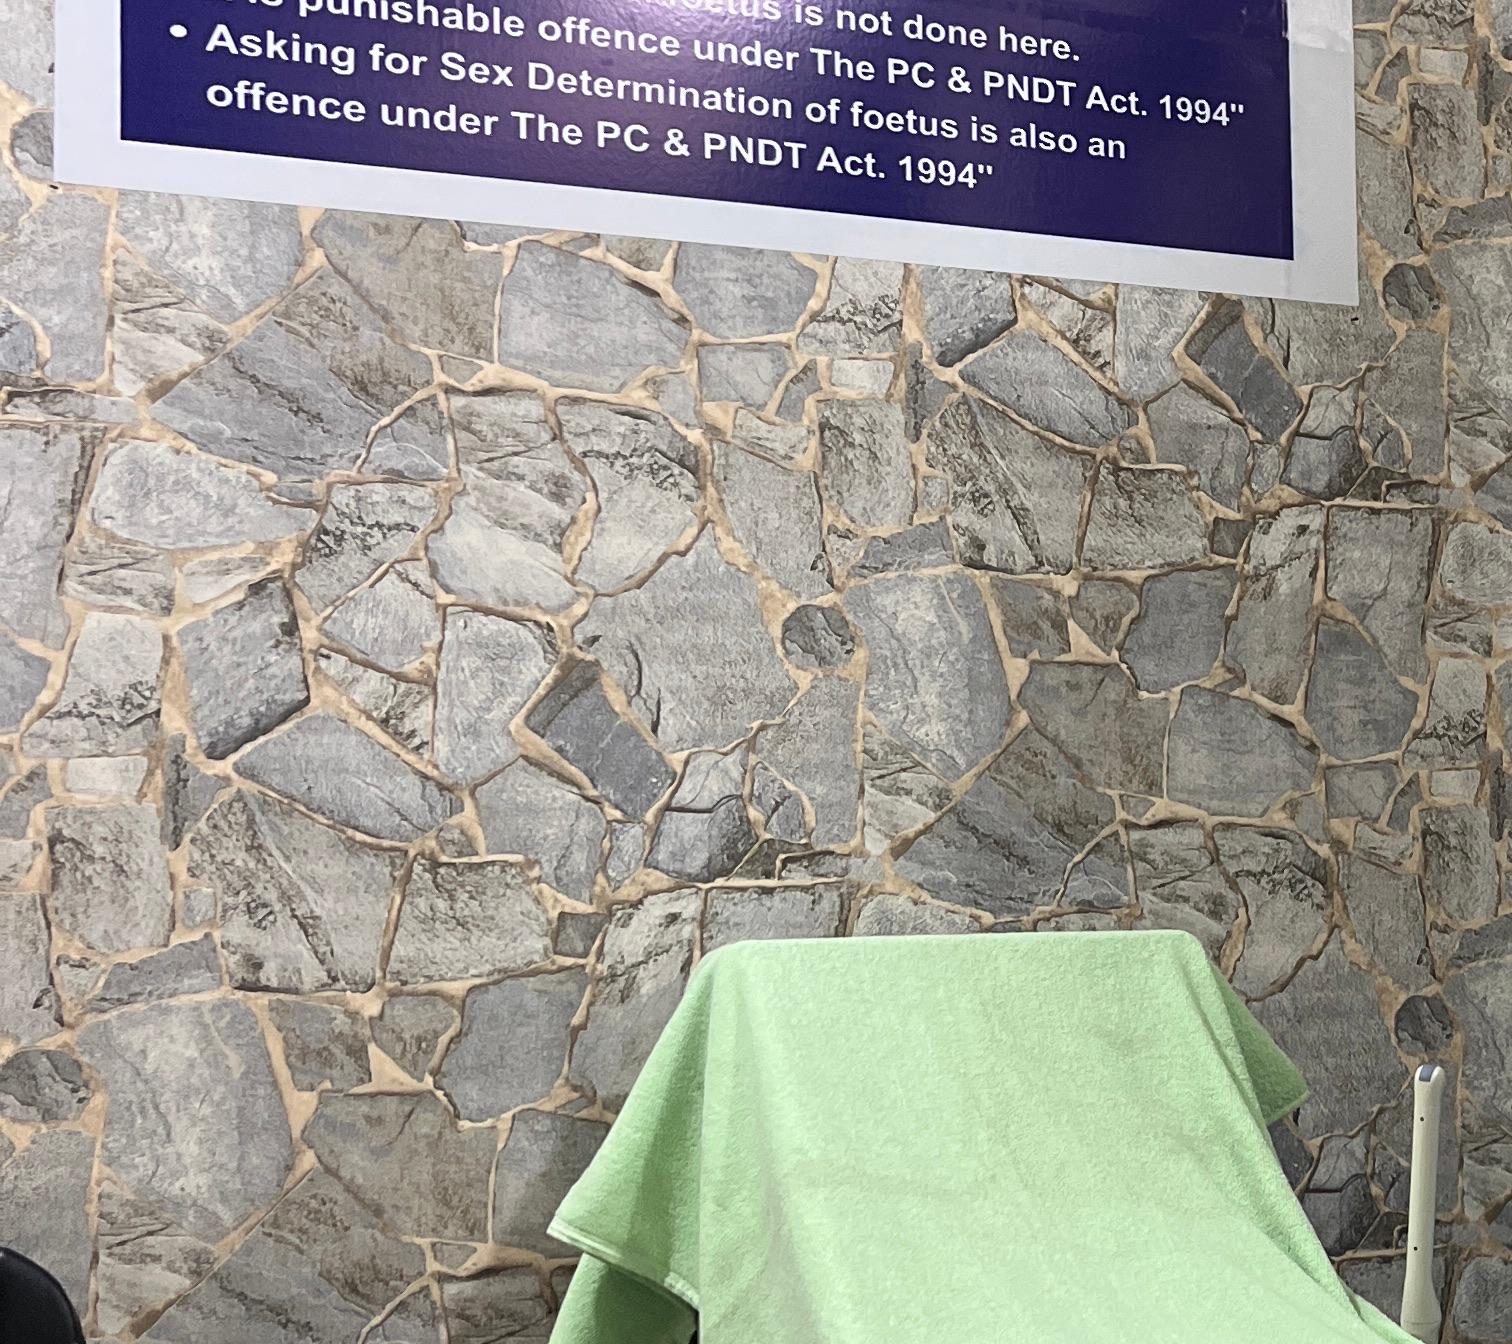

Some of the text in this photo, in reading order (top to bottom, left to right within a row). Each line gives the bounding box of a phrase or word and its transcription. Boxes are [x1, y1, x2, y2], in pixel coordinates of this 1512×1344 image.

[538, 14, 681, 57] offence
[693, 38, 799, 71] under
[808, 46, 875, 81] The
[887, 57, 935, 88] PC
[947, 65, 972, 93] &
[983, 70, 1076, 106] PNDT
[1085, 84, 1147, 116] Act.
[902, 13, 987, 48] done
[999, 25, 1080, 61] here.
[204, 23, 1125, 159] Asking for Sex Determination of foetus is also an
[205, 79, 366, 122] offence
[380, 103, 499, 136] under
[510, 110, 583, 145] The
[596, 120, 649, 152] PC
[663, 128, 690, 157] &
[703, 131, 807, 169] PNDT
[816, 145, 885, 178] Act.
